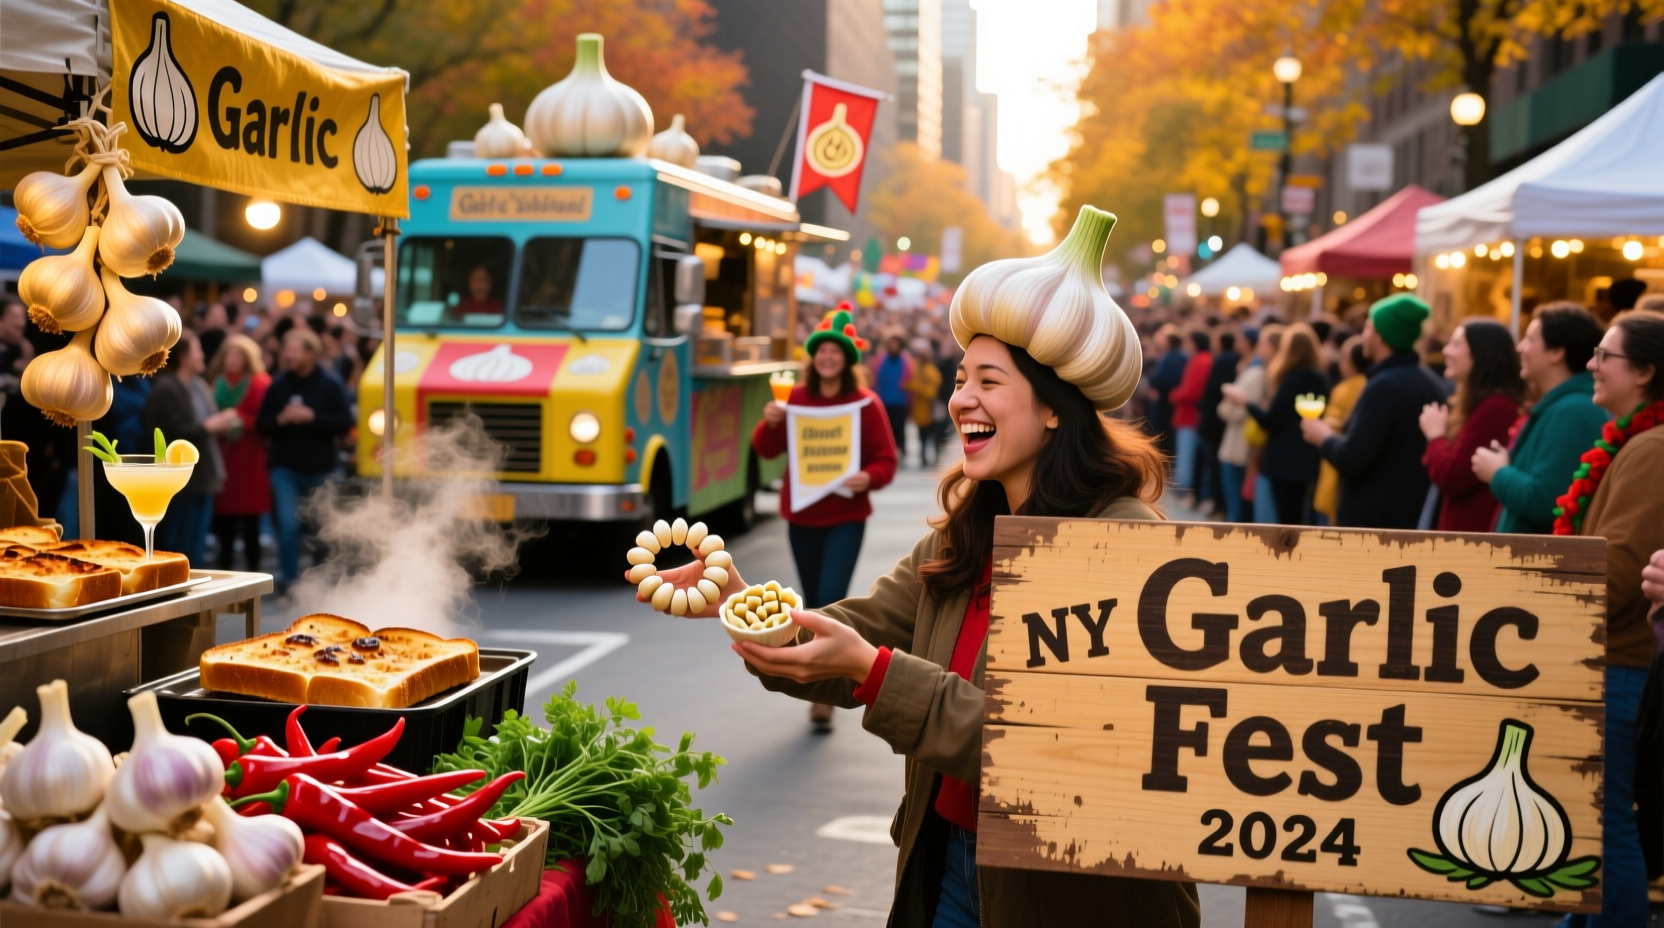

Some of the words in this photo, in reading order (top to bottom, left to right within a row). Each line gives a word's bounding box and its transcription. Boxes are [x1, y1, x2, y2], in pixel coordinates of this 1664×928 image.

[207, 65, 338, 169] Garlic
[1021, 598, 1118, 668] NY
[1137, 557, 1540, 689] Garlic
[1141, 685, 1422, 806] Fest
[1198, 808, 1361, 867] 2024
